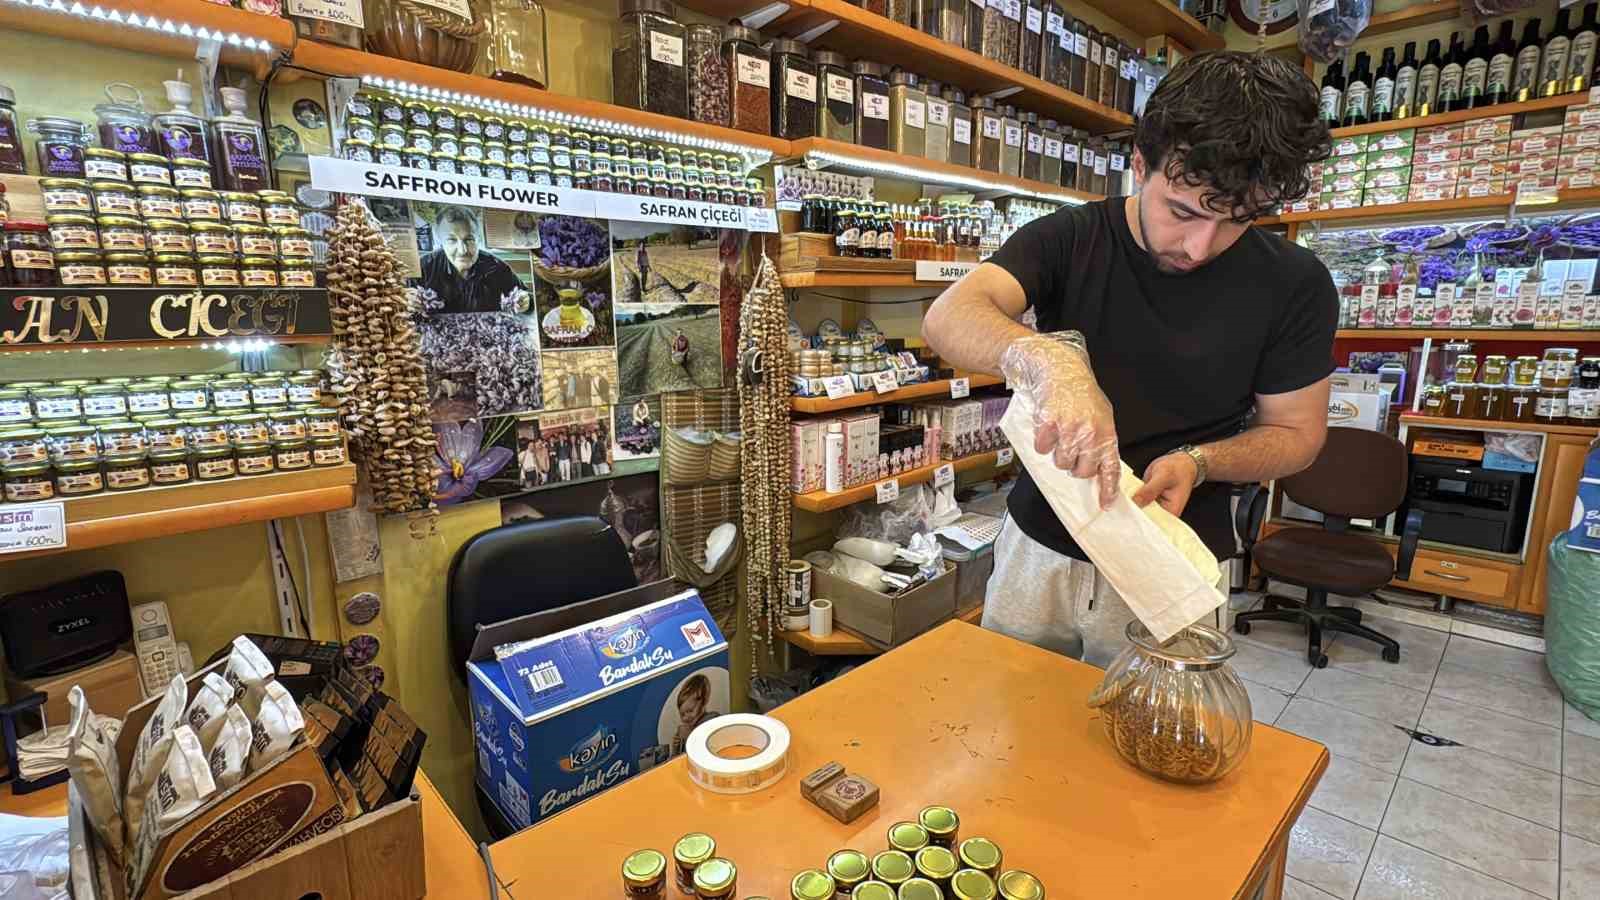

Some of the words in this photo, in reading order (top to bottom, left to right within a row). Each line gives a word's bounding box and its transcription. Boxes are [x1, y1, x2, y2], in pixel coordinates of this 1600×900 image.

[365, 171, 472, 198] SAFFRON
[479, 184, 560, 207] FLOWER
[640, 202, 697, 219] SAFRAN
[700, 205, 742, 224] ÇİÇEĞİ
[58, 617, 91, 633] ZYXEL
